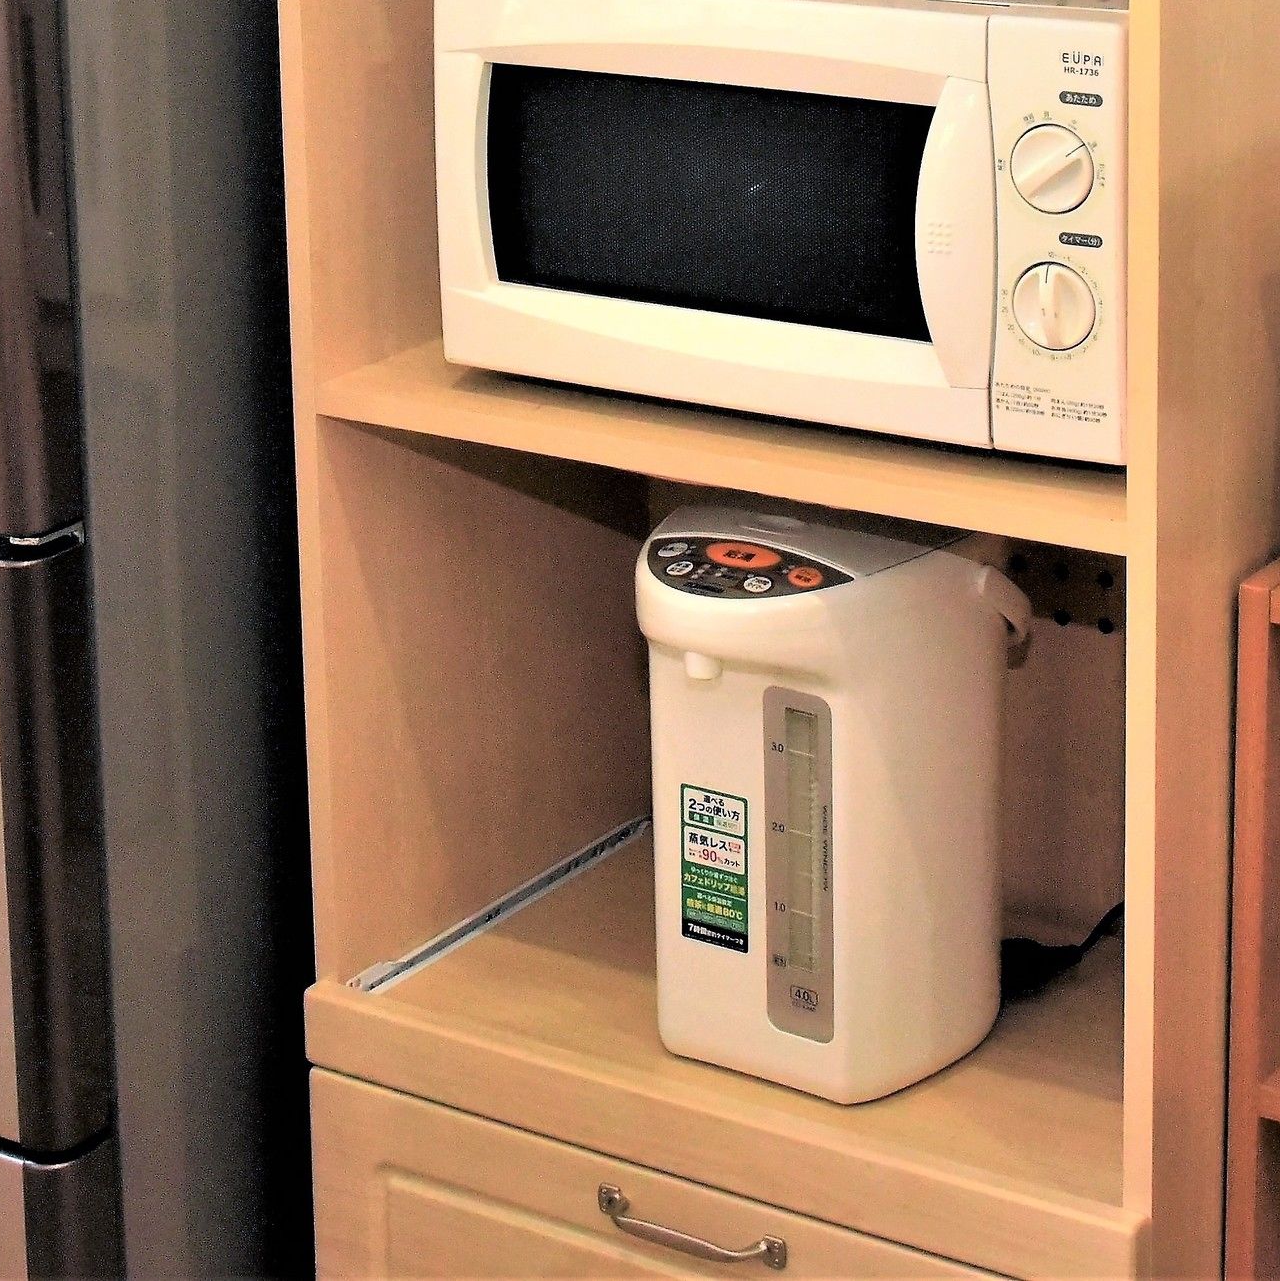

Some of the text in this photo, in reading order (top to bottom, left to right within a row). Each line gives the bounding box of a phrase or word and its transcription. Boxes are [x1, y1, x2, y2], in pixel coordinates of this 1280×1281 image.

[688, 798, 741, 821] 2つの使い方
[772, 821, 785, 834] 2.0
[688, 832, 729, 852] 蒸気レス
[774, 901, 787, 913] 1.0
